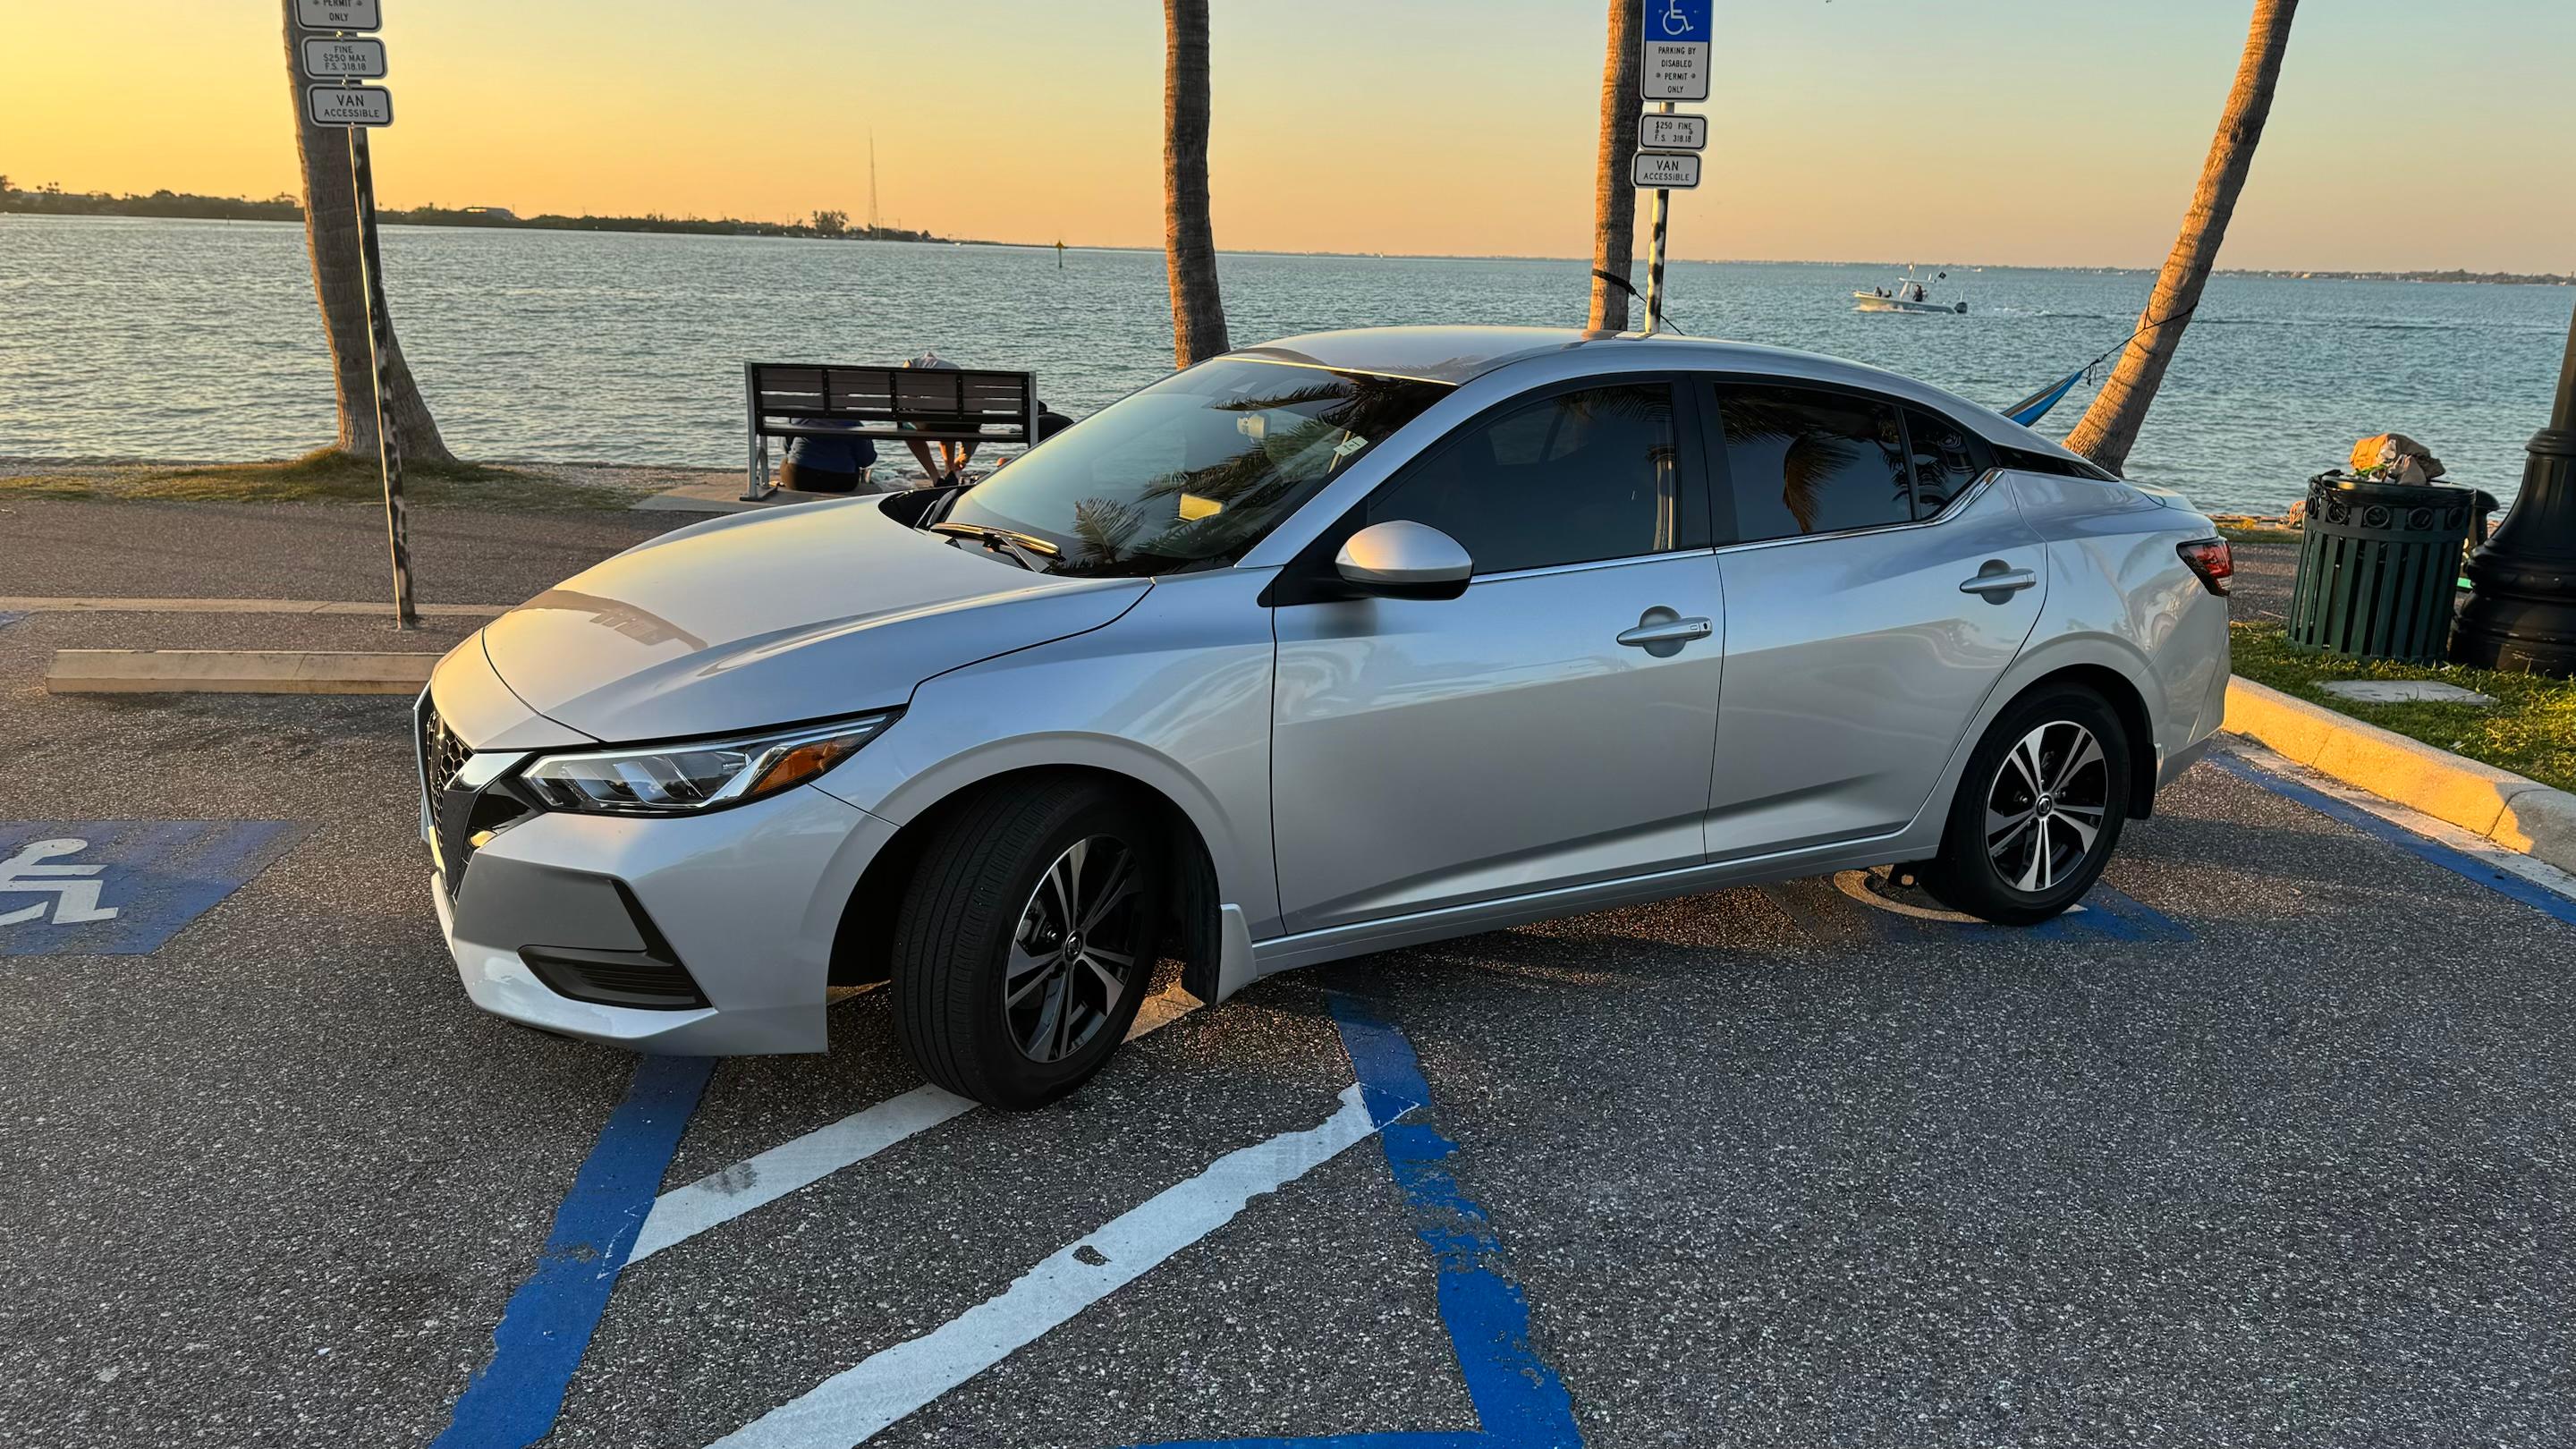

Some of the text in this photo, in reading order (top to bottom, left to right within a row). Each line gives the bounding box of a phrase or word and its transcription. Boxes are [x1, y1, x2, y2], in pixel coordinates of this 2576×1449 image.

[329, 13, 349, 22] ONLY
[334, 46, 353, 54] FINE
[1658, 46, 1696, 55] PARKING BY
[323, 53, 366, 63] $250 MAX
[1661, 59, 1692, 68] DISABLED
[1664, 72, 1688, 81] PERMIT
[1667, 85, 1684, 93] ONLY
[336, 94, 364, 106] VAN
[324, 109, 379, 118] ACCESSIBLE
[1656, 120, 1692, 131] $250 FINE
[1657, 160, 1679, 171] VAN
[1643, 173, 1690, 181] ACCESSIBLE
